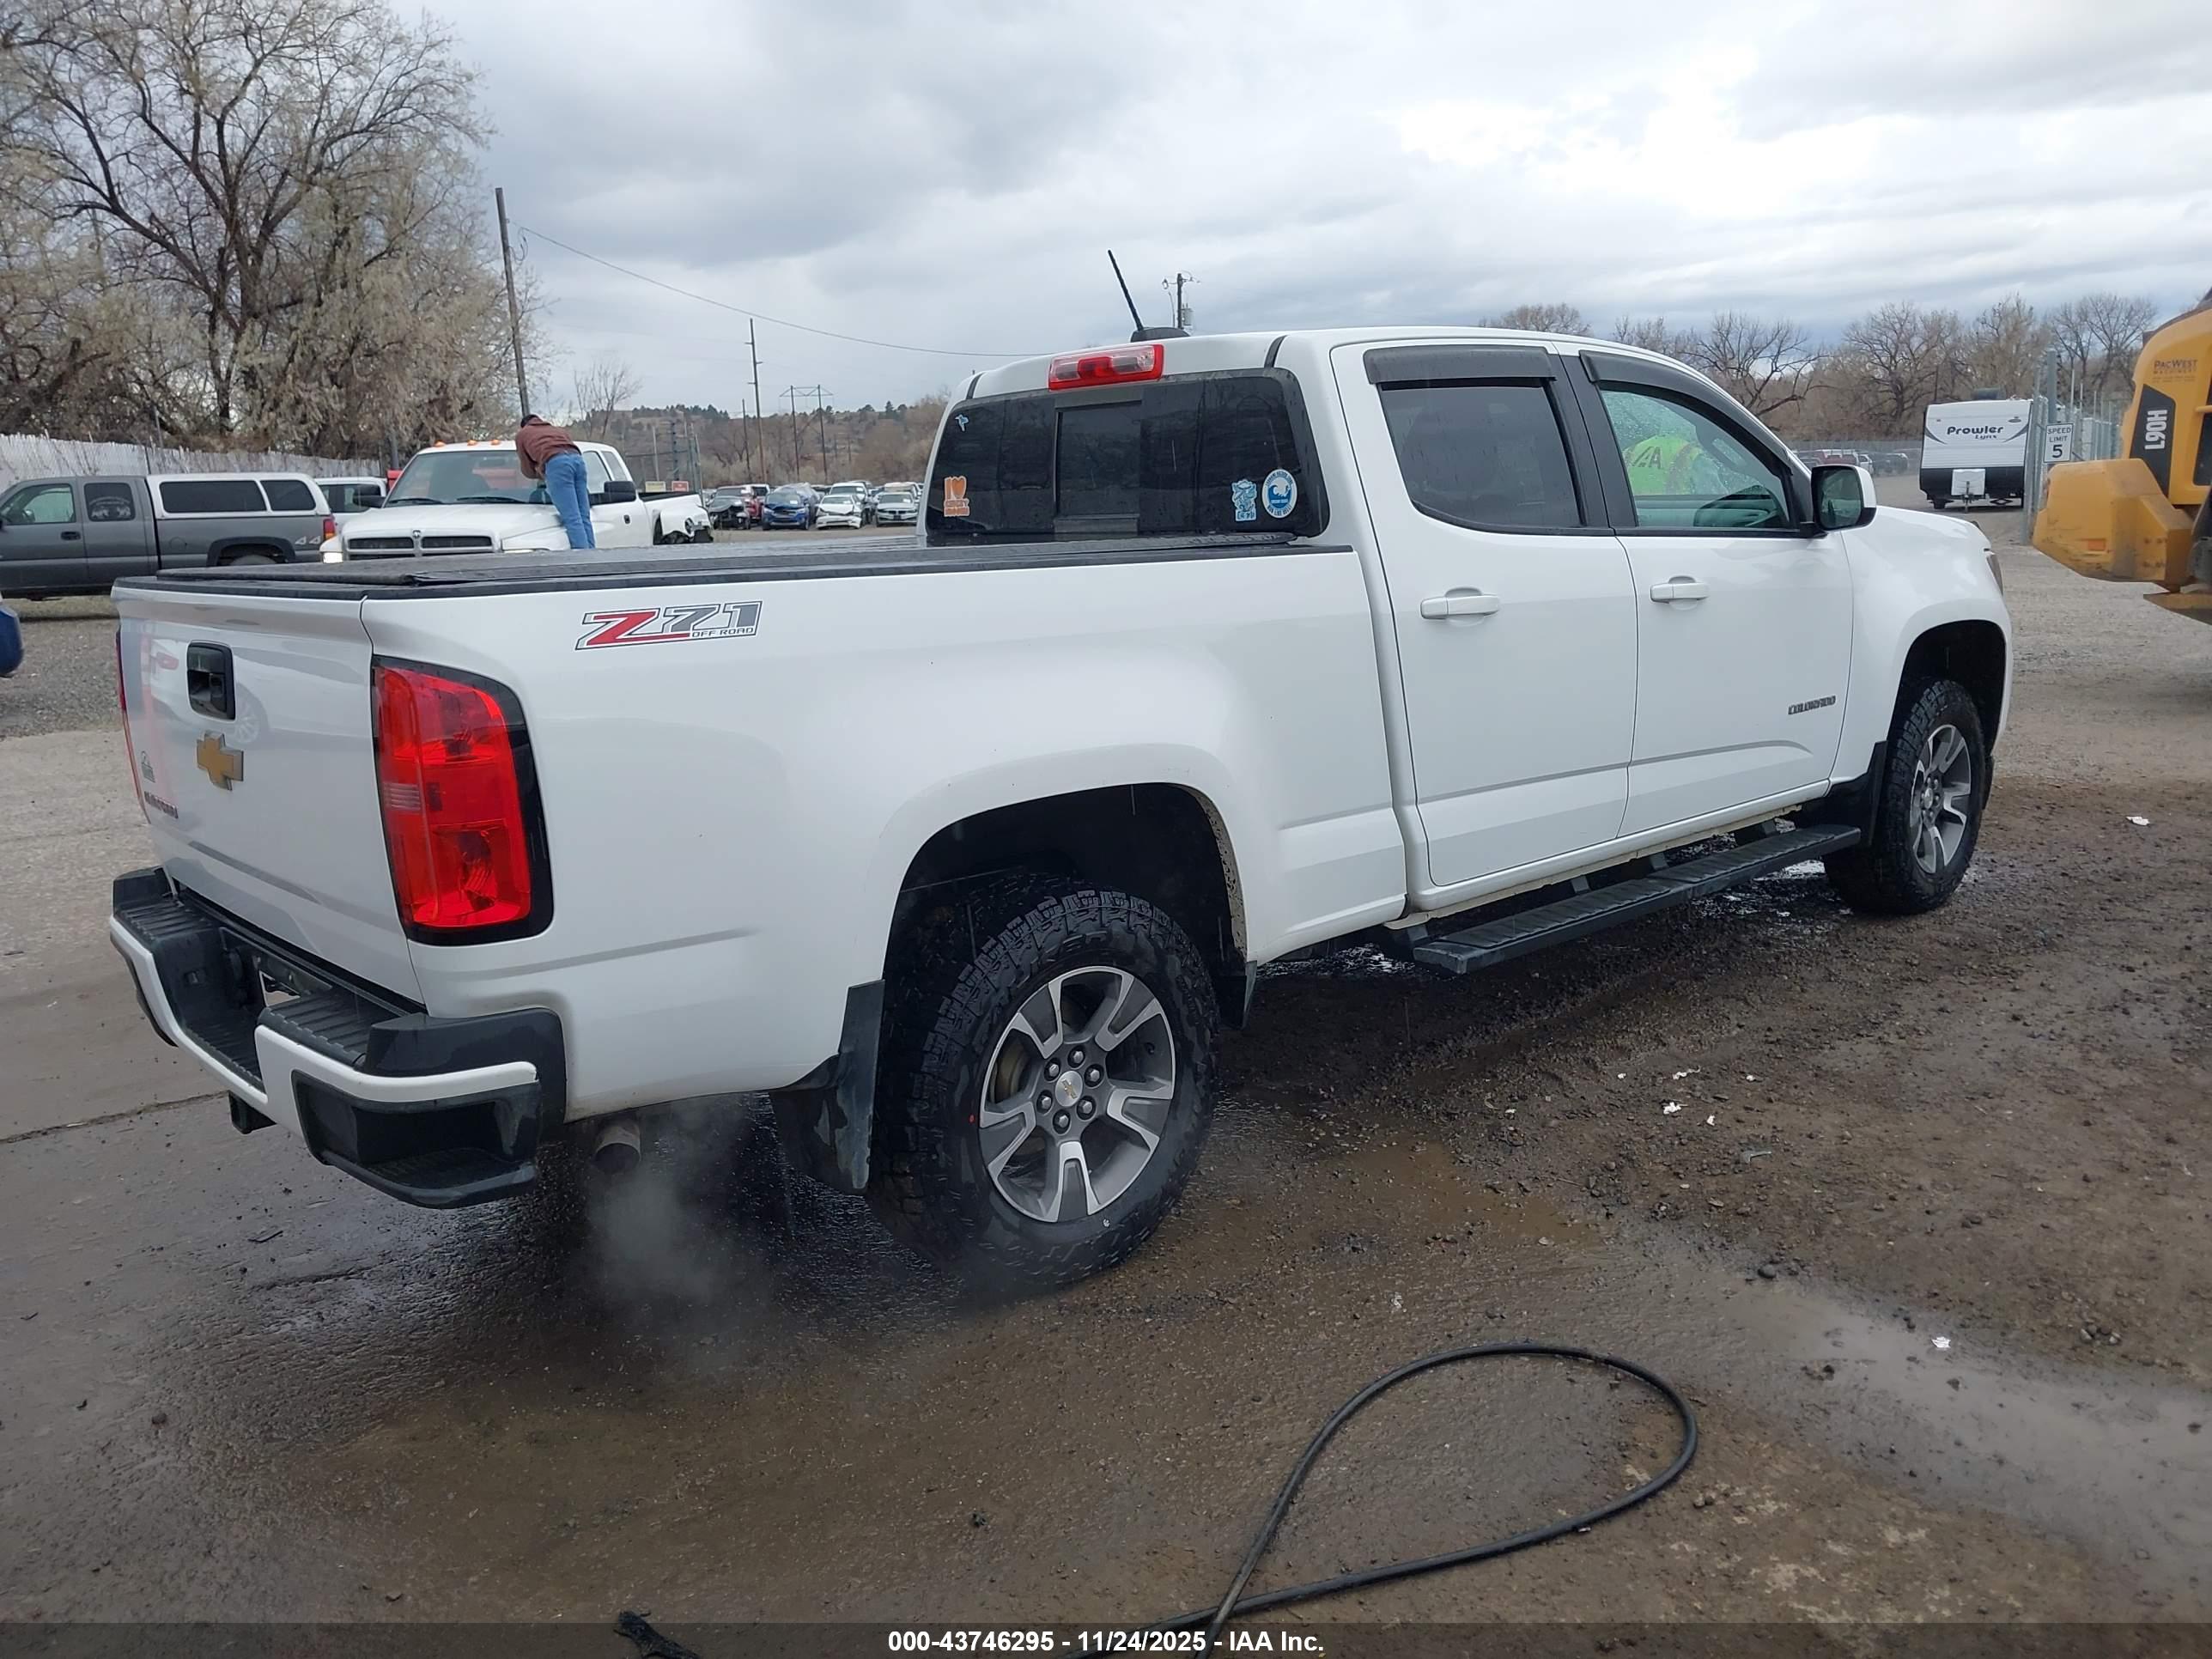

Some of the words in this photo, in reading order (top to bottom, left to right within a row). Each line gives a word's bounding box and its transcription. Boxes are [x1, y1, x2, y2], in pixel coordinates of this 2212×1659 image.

[1947, 426, 2004, 434] Prowler
[2145, 410, 2167, 449] L90H
[2052, 444, 2063, 459] 5
[574, 601, 763, 650] Z71
[720, 628, 754, 636] ROAD
[1788, 696, 1836, 714] COLORADO
